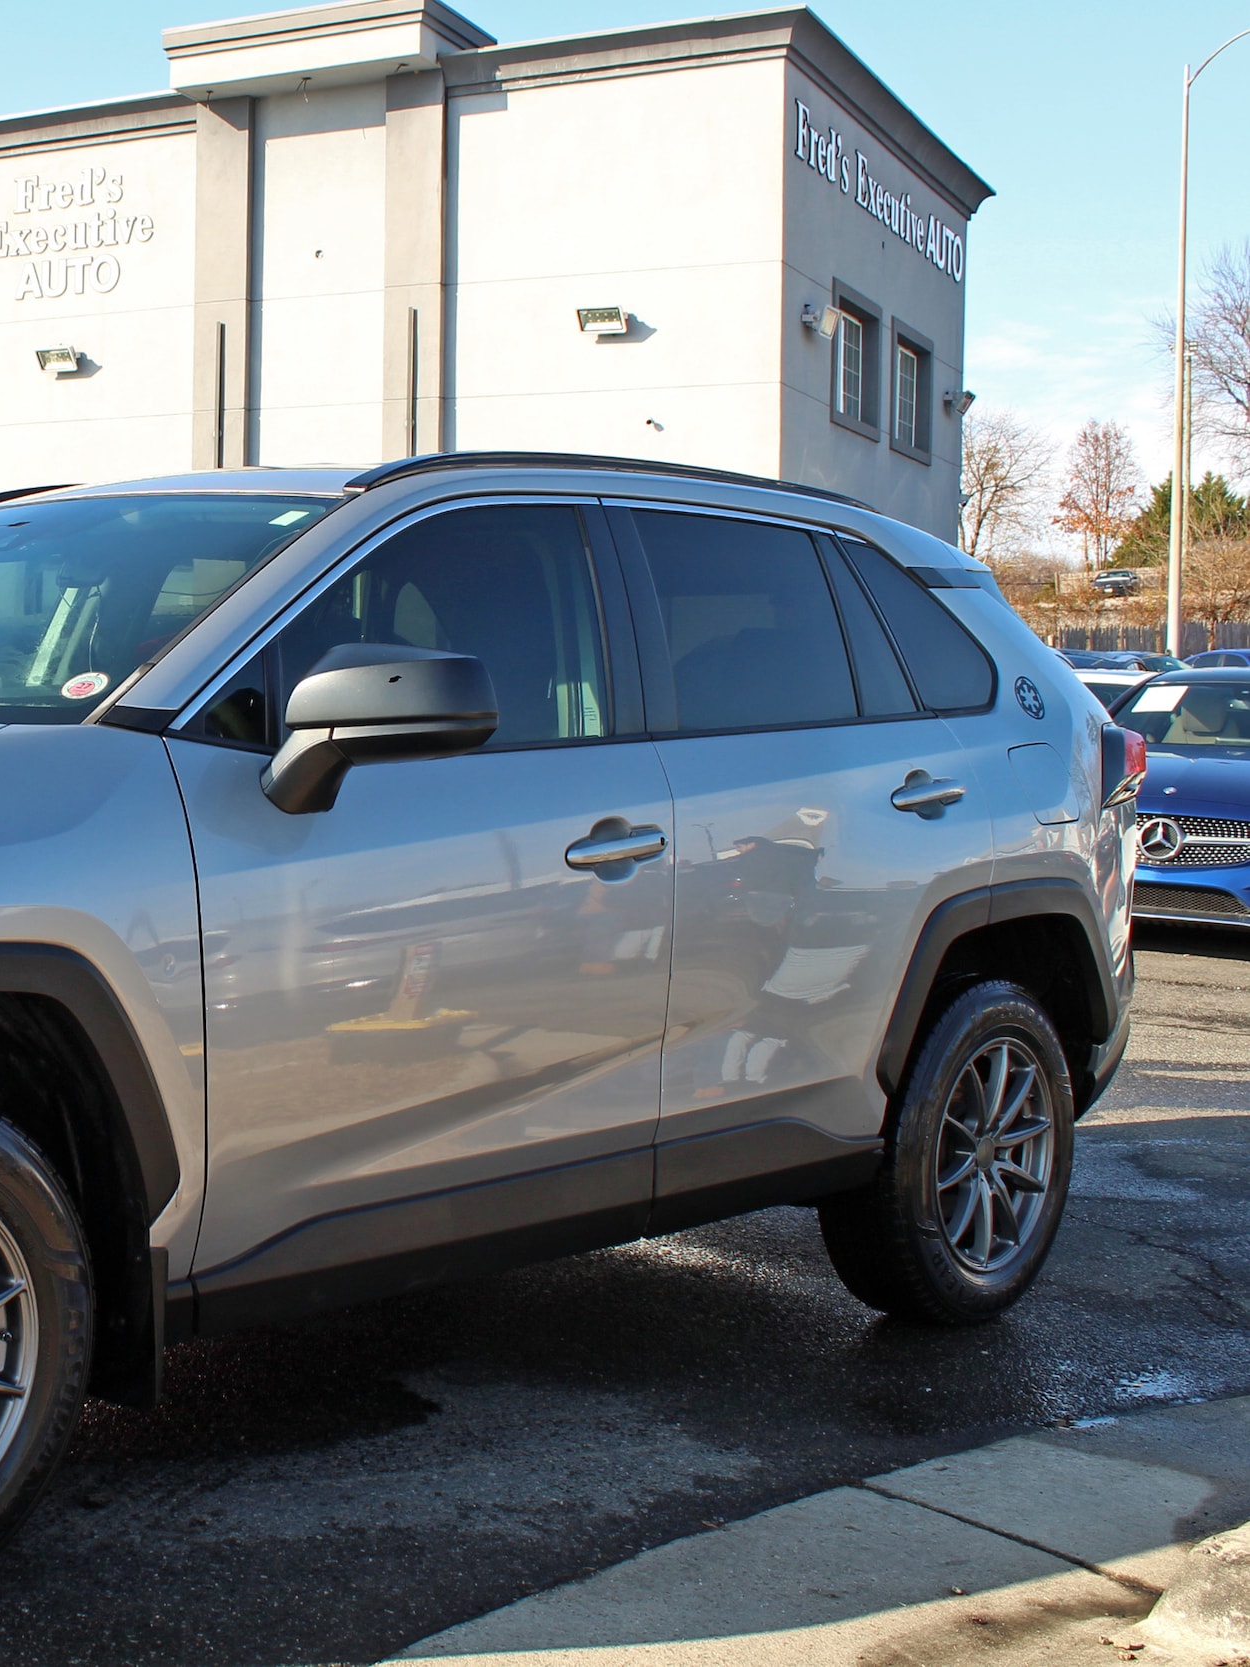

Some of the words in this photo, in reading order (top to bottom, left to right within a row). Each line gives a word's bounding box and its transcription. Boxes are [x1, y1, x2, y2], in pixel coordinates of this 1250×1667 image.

[13, 167, 124, 215] Fred's
[795, 98, 850, 195] Fred's
[855, 149, 925, 253] Executive
[925, 213, 964, 283] AUTO
[15, 254, 121, 301] AUTO
